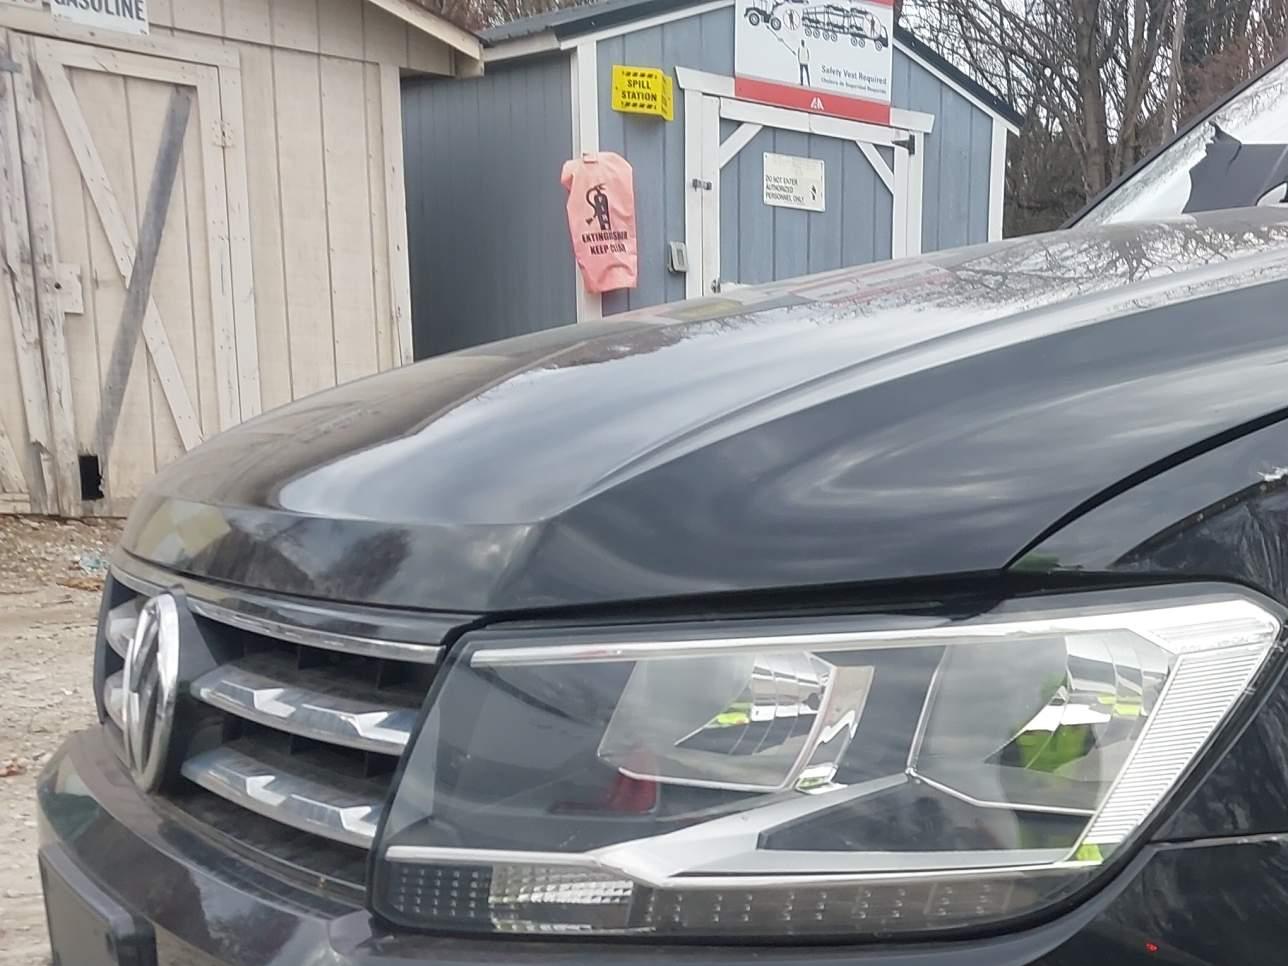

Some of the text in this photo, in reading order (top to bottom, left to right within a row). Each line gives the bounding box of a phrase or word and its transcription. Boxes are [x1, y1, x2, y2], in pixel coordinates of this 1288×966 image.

[53, 0, 146, 21] OLINE
[843, 69, 857, 80] Vest
[859, 72, 887, 85] Required
[627, 79, 652, 90] SPILL
[621, 91, 657, 102] STATION
[590, 244, 609, 255] KEEP
